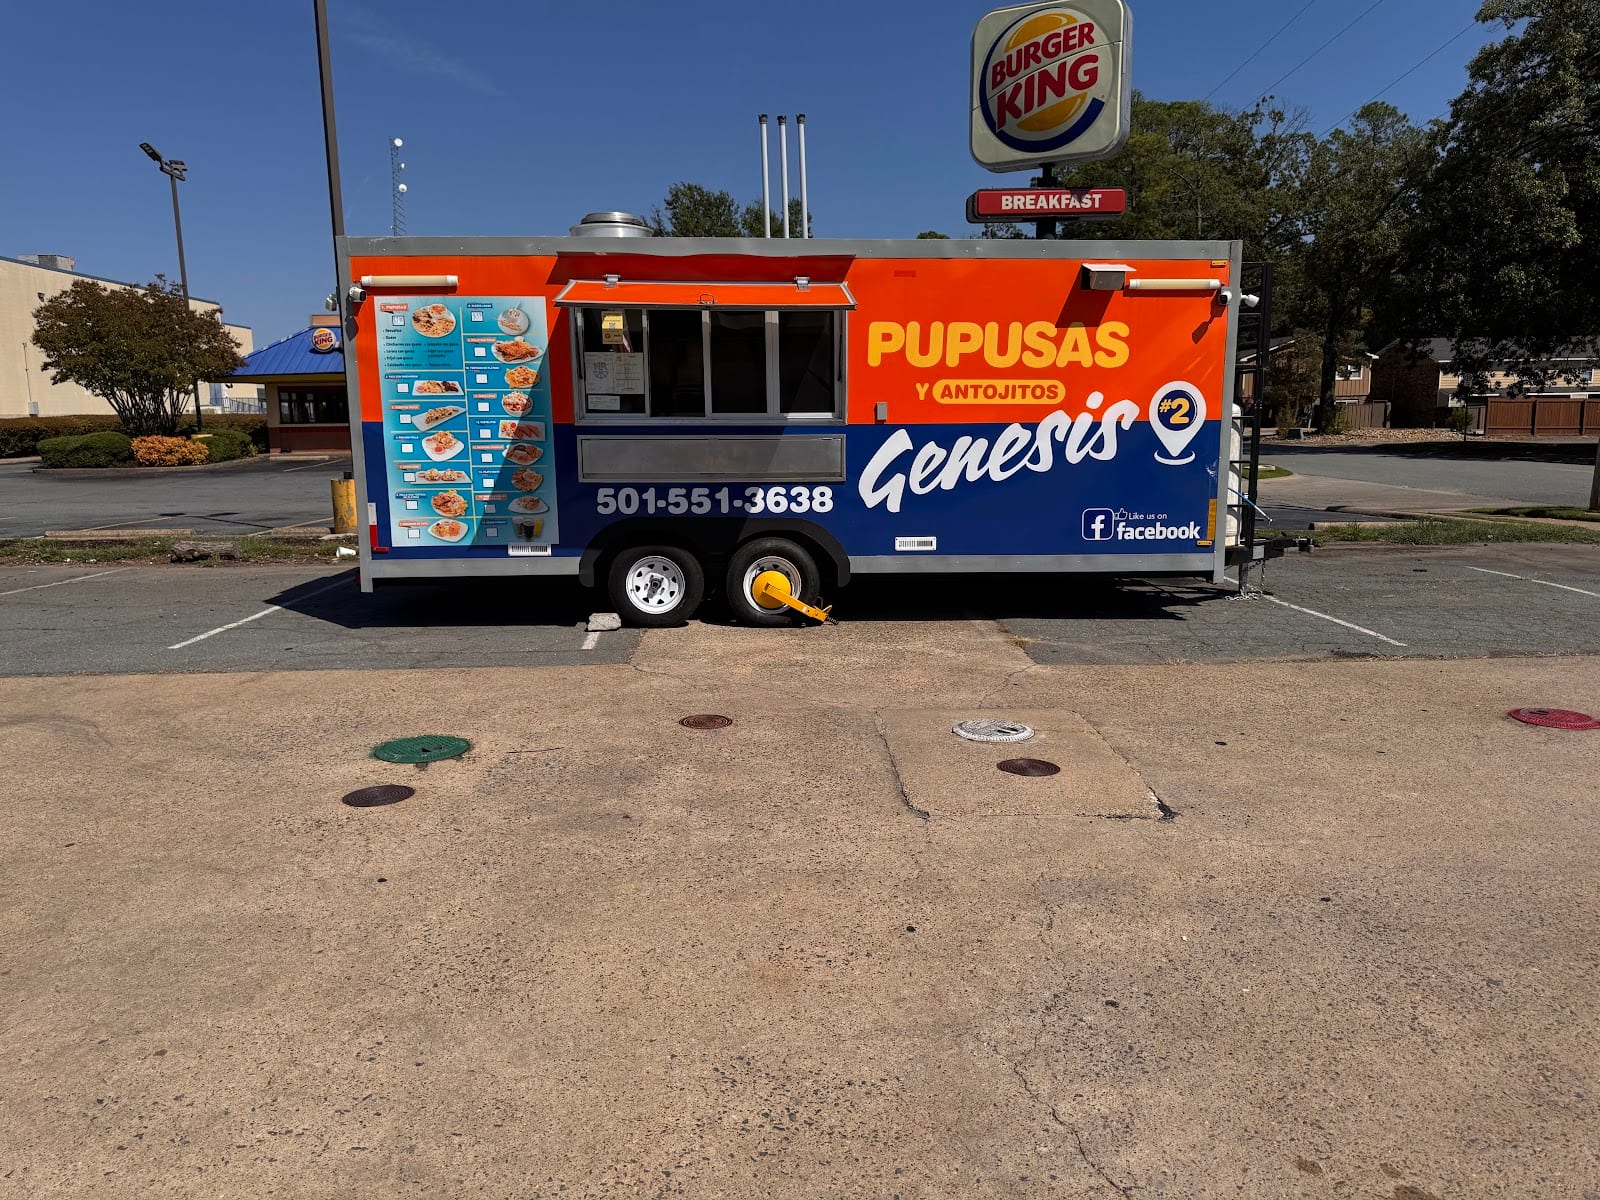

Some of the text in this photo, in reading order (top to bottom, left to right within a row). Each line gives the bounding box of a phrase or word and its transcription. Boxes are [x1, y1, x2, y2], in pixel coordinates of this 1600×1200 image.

[991, 22, 1095, 91] BURGER
[995, 54, 1099, 130] KING
[1001, 193, 1102, 210] BREAKFAST
[314, 336, 333, 345] KING
[867, 320, 1130, 369] PUPUSAS
[915, 382, 1059, 401] Y ANTOJITOS
[1158, 397, 1190, 424] #2
[858, 391, 1140, 513] Genesis
[596, 485, 834, 515] 501-551-3638
[1128, 512, 1144, 520] Like
[1116, 520, 1201, 540] facebook
